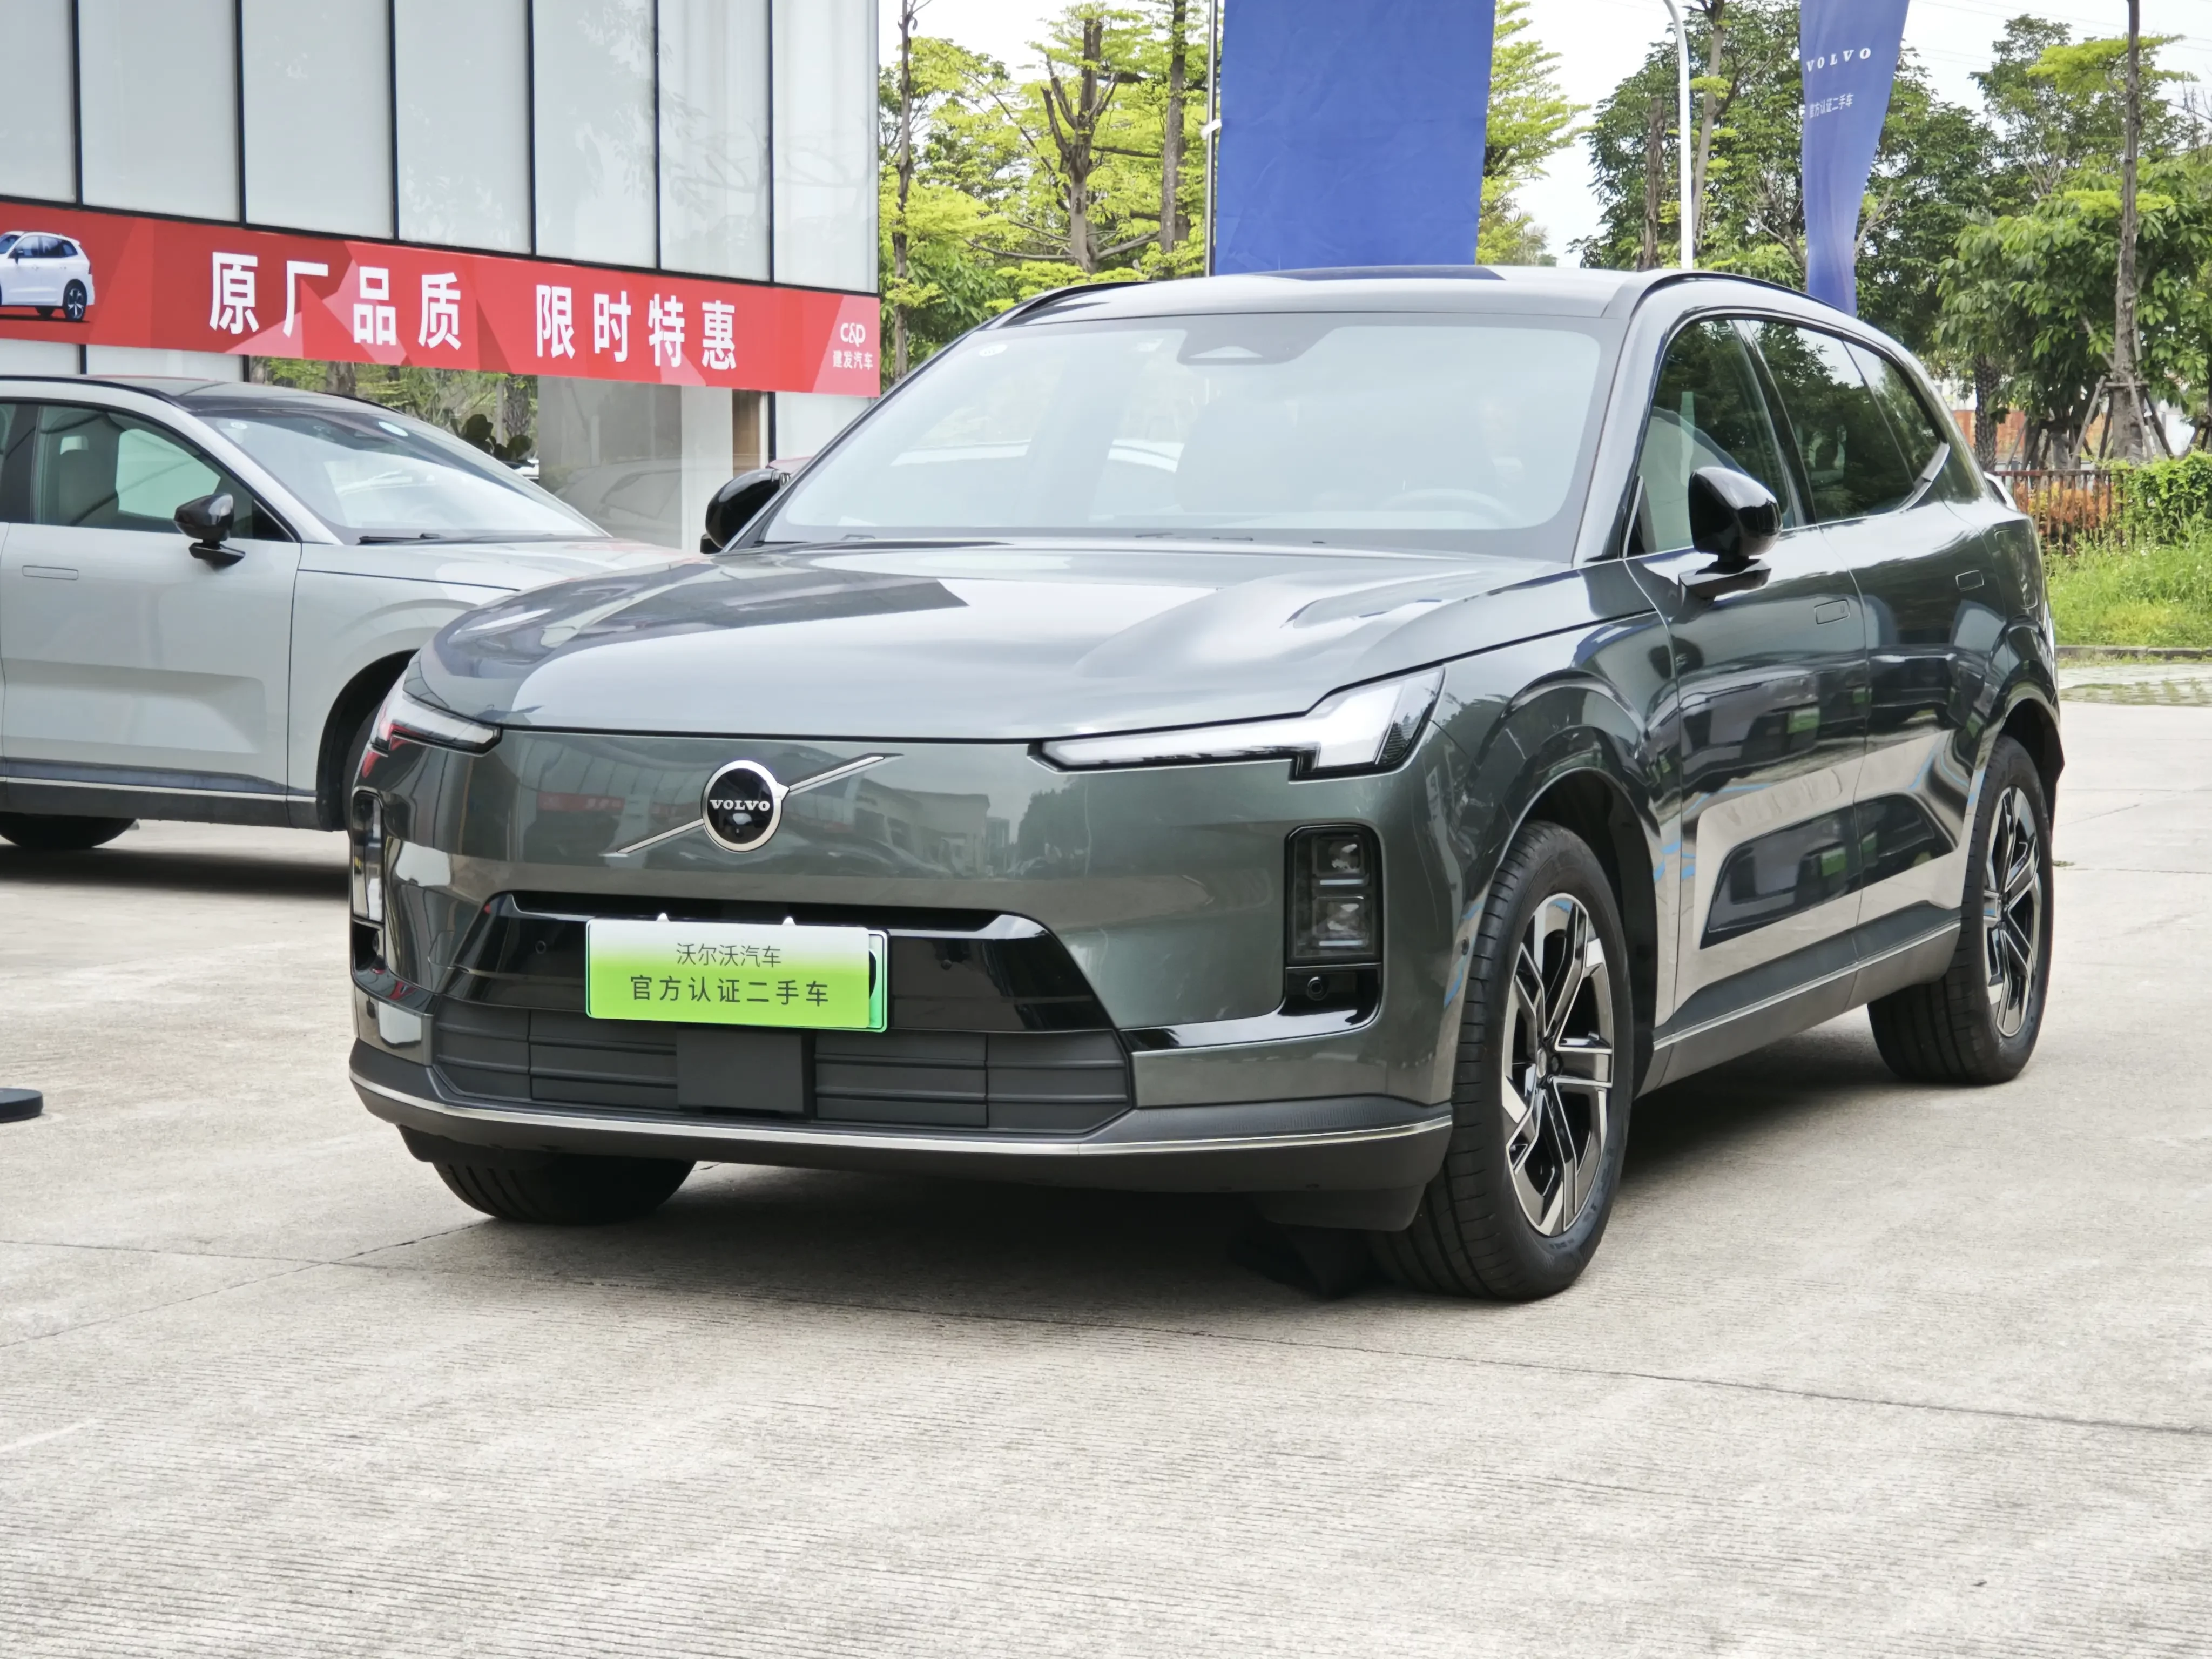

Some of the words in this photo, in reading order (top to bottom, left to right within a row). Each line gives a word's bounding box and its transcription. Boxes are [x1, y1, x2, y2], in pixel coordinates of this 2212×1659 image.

[1806, 48, 1871, 72] VOLVO
[210, 252, 462, 349] 原厂品质
[536, 284, 737, 370] 限时特惠
[840, 322, 866, 347] C&D
[833, 350, 873, 370] 建发汽车
[710, 799, 770, 812] VOLVO
[676, 942, 782, 968] 沃尔沃汽车
[630, 975, 829, 1006] 官方认证二手车
